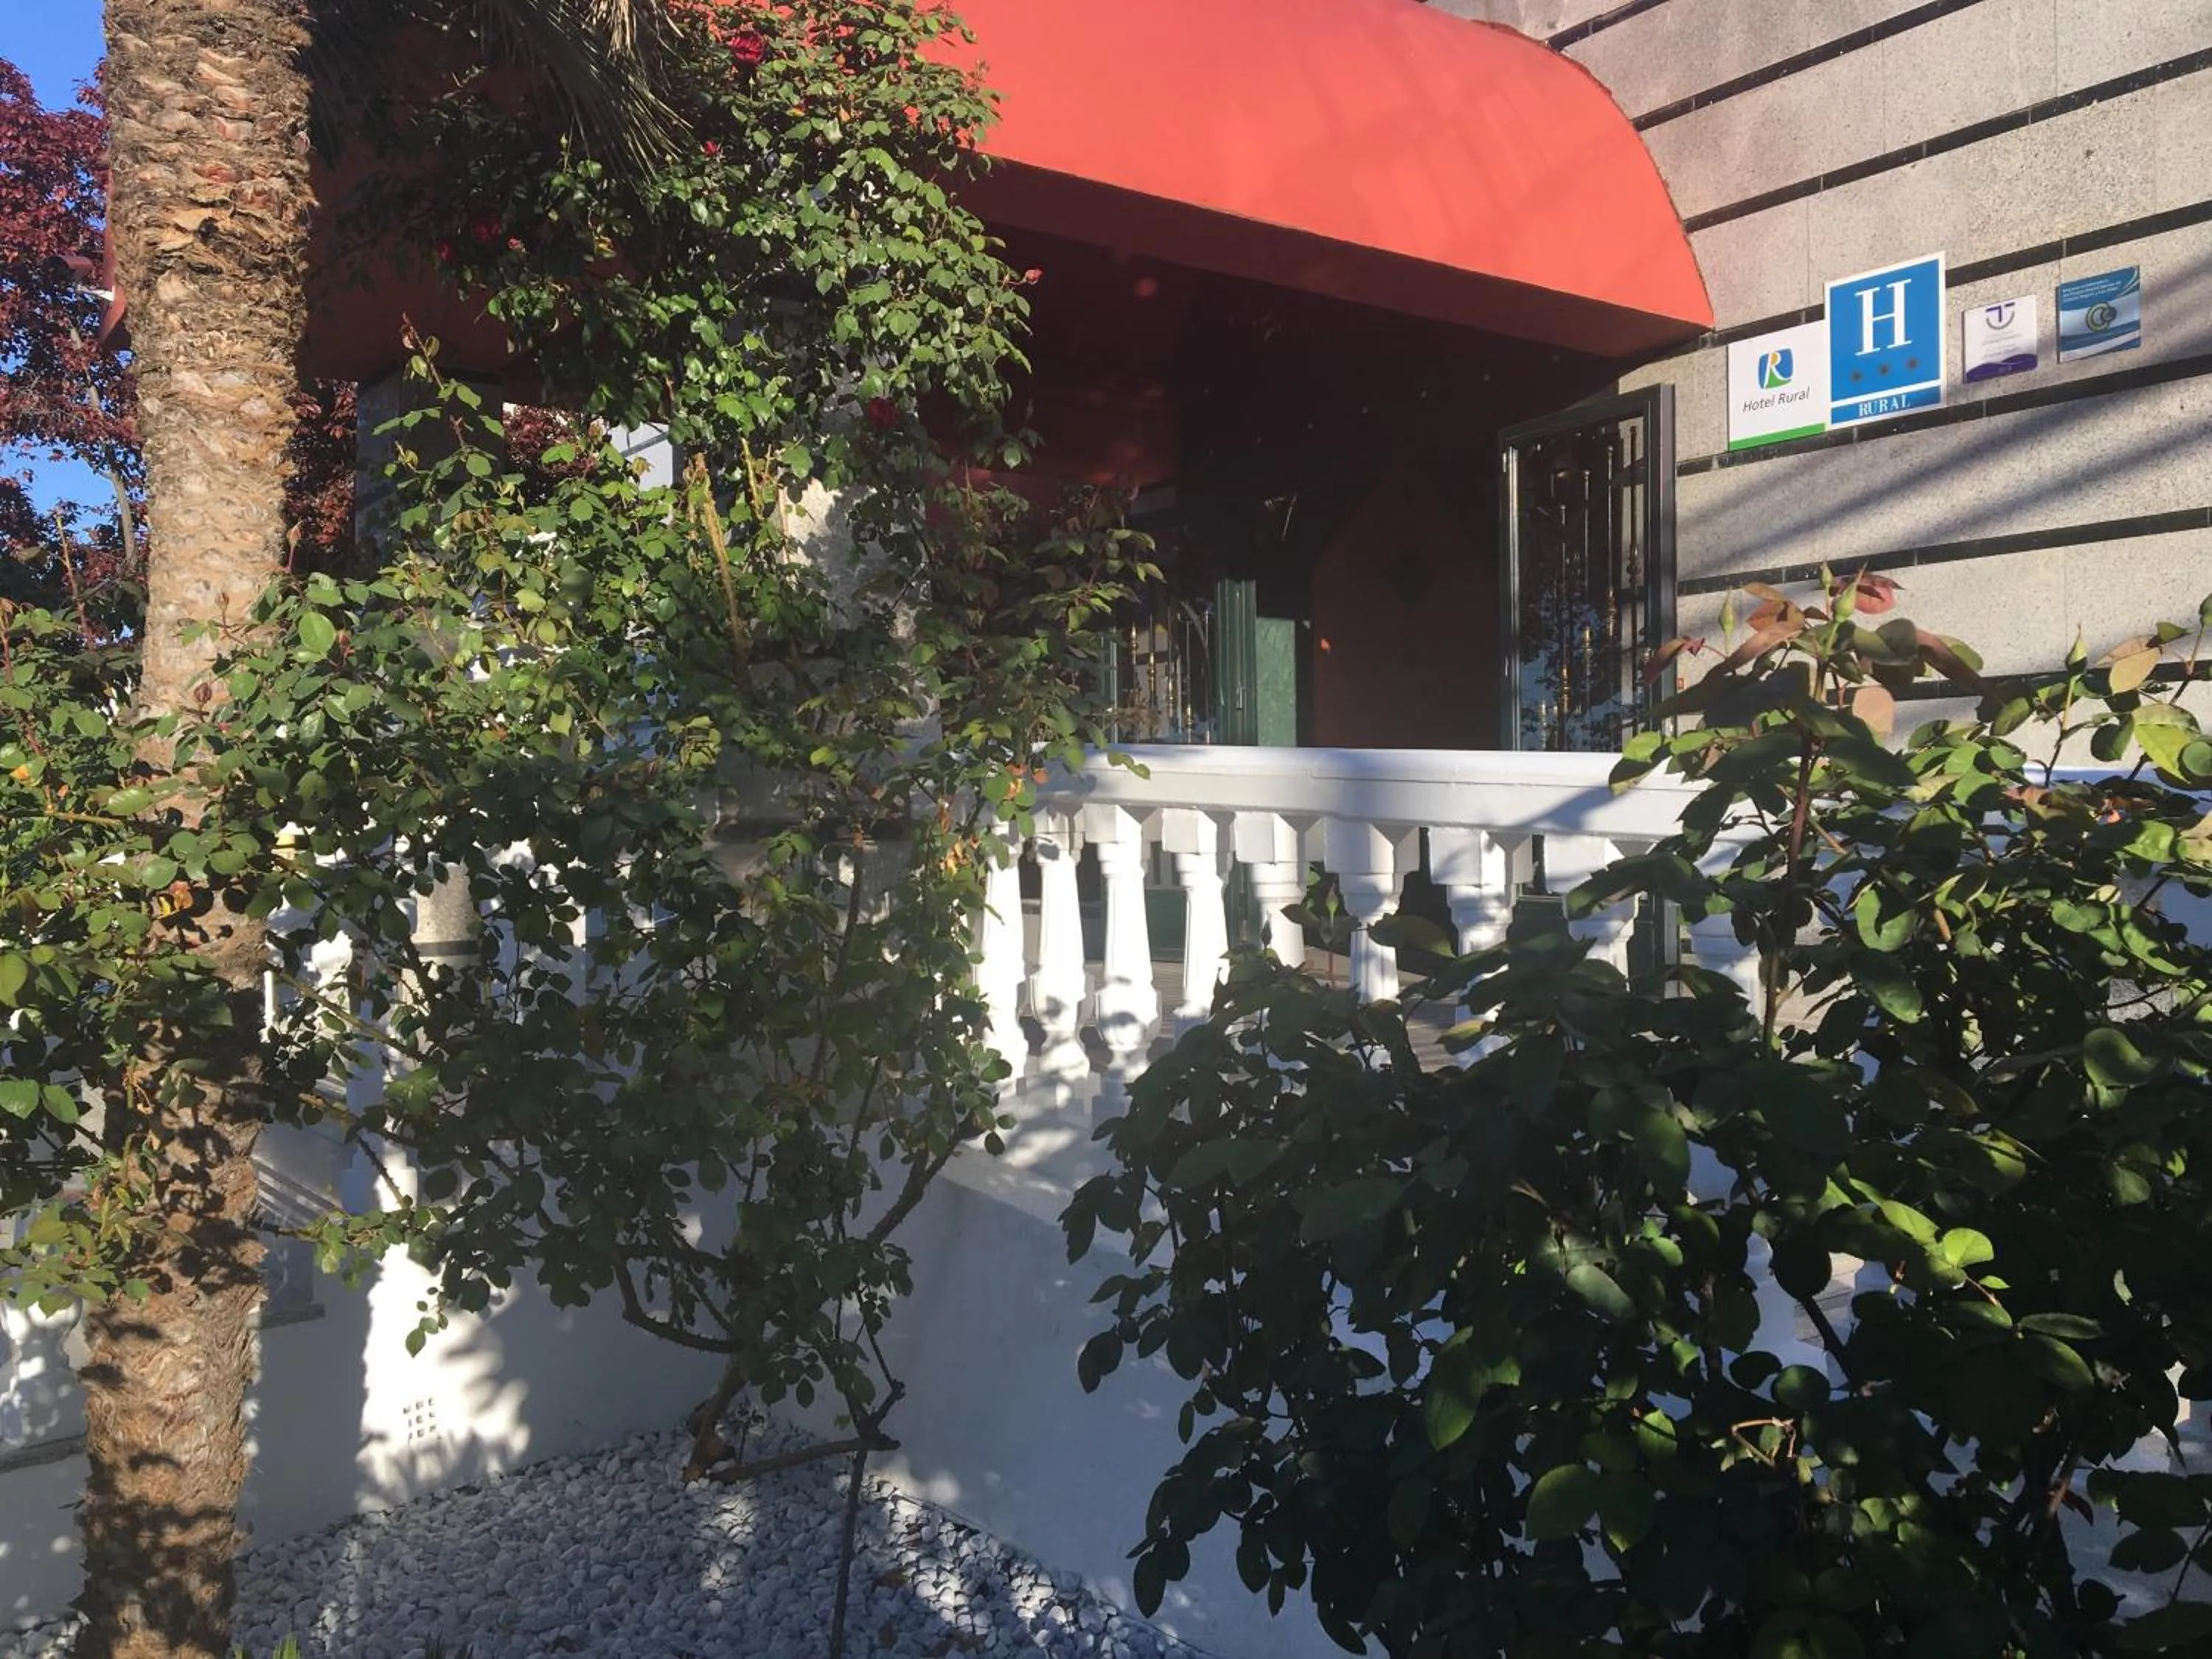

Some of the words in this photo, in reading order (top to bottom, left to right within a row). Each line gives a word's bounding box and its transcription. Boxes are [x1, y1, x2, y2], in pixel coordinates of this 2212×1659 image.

[1854, 279, 1912, 355] H
[1742, 395, 1775, 413] Hotel
[1778, 386, 1810, 404] Rural
[1858, 394, 1910, 417] RURAL
